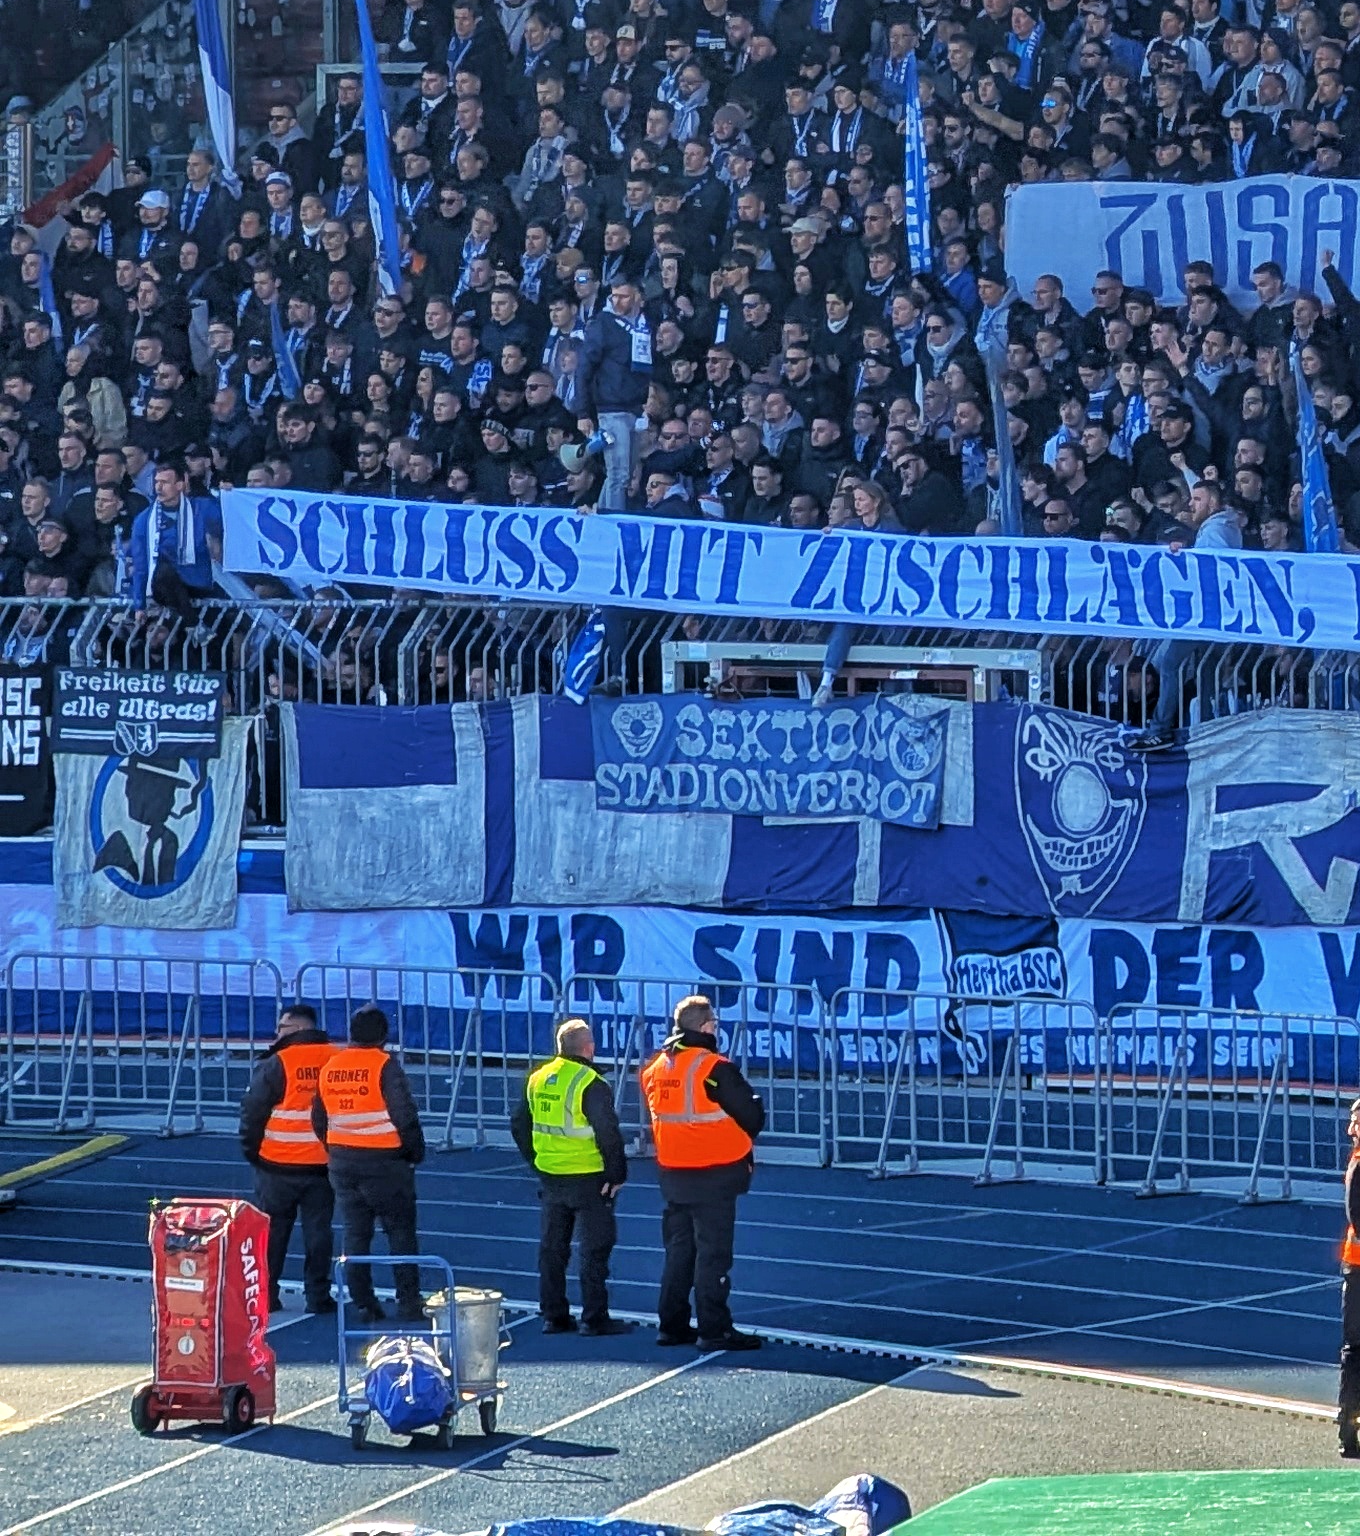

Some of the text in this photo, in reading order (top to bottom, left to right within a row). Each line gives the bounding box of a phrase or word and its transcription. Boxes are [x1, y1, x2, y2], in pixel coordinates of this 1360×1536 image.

[257, 496, 582, 593] SCHLUSS
[610, 521, 762, 602] MIT
[0, 677, 41, 716] SC
[59, 670, 220, 695] Freiheit für
[61, 695, 218, 722] alle Ultras!
[676, 703, 897, 763] SEKTION
[596, 763, 936, 823] STADIONVERBOT
[450, 911, 627, 1003] WIR
[692, 923, 920, 1017] SIND
[1089, 927, 1266, 1020] DER
[327, 1068, 370, 1084] ORDNER
